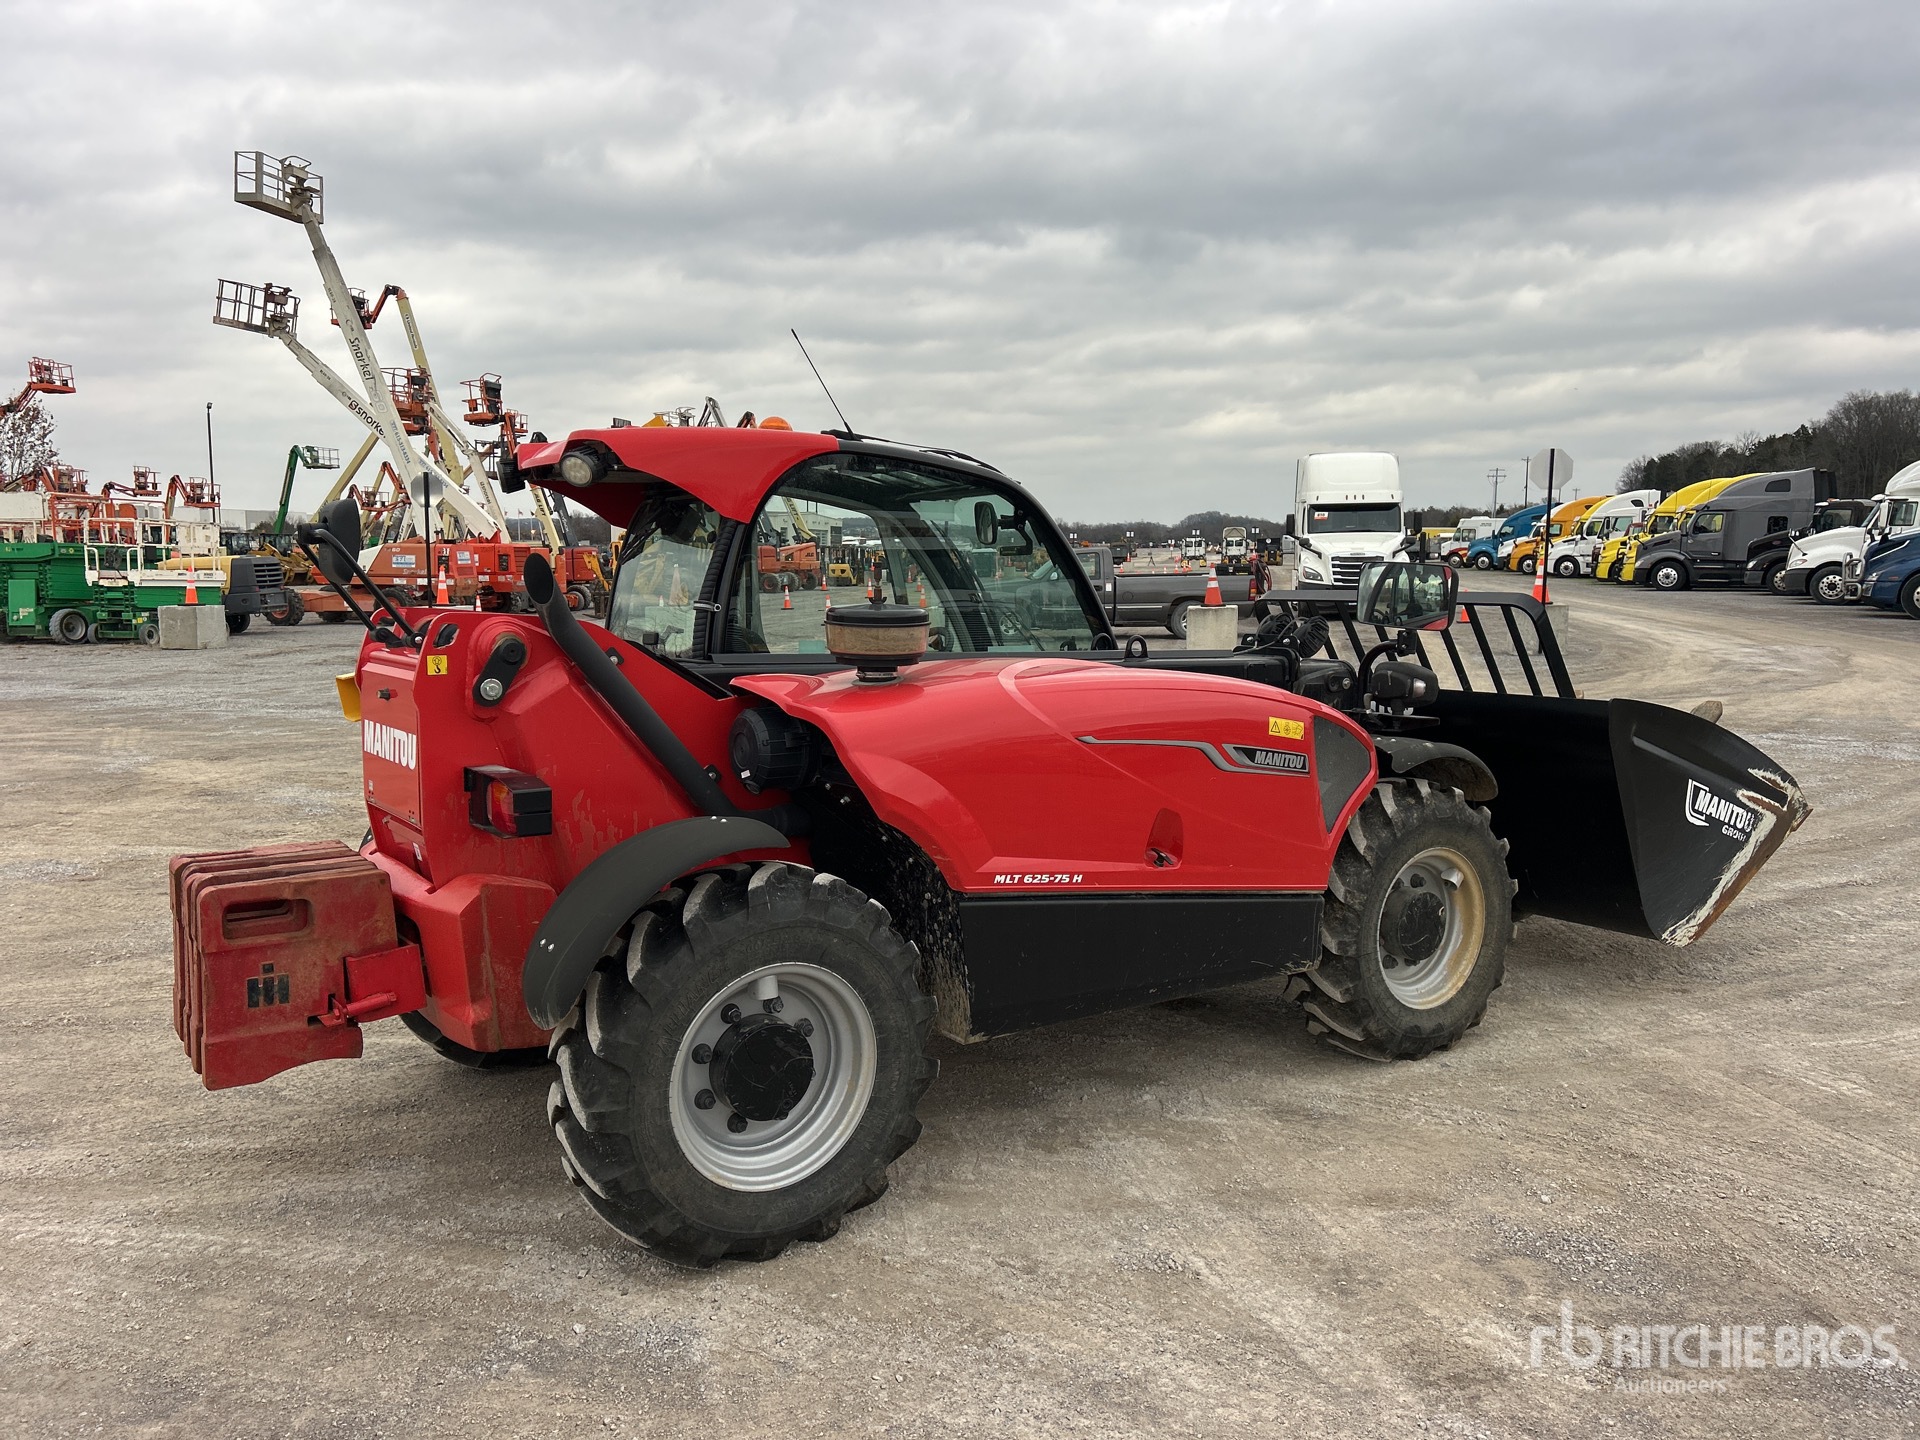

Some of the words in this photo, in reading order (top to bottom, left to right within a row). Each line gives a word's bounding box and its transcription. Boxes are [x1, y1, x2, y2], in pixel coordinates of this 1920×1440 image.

[349, 337, 375, 381] Snorkel
[356, 406, 386, 439] snorke
[364, 719, 416, 770] MANITOU
[1254, 750, 1304, 769] MANITOU
[1694, 789, 1754, 833] MANITOU
[994, 874, 1022, 884] MLT
[1023, 874, 1070, 884] 625-75
[1072, 874, 1083, 883] H
